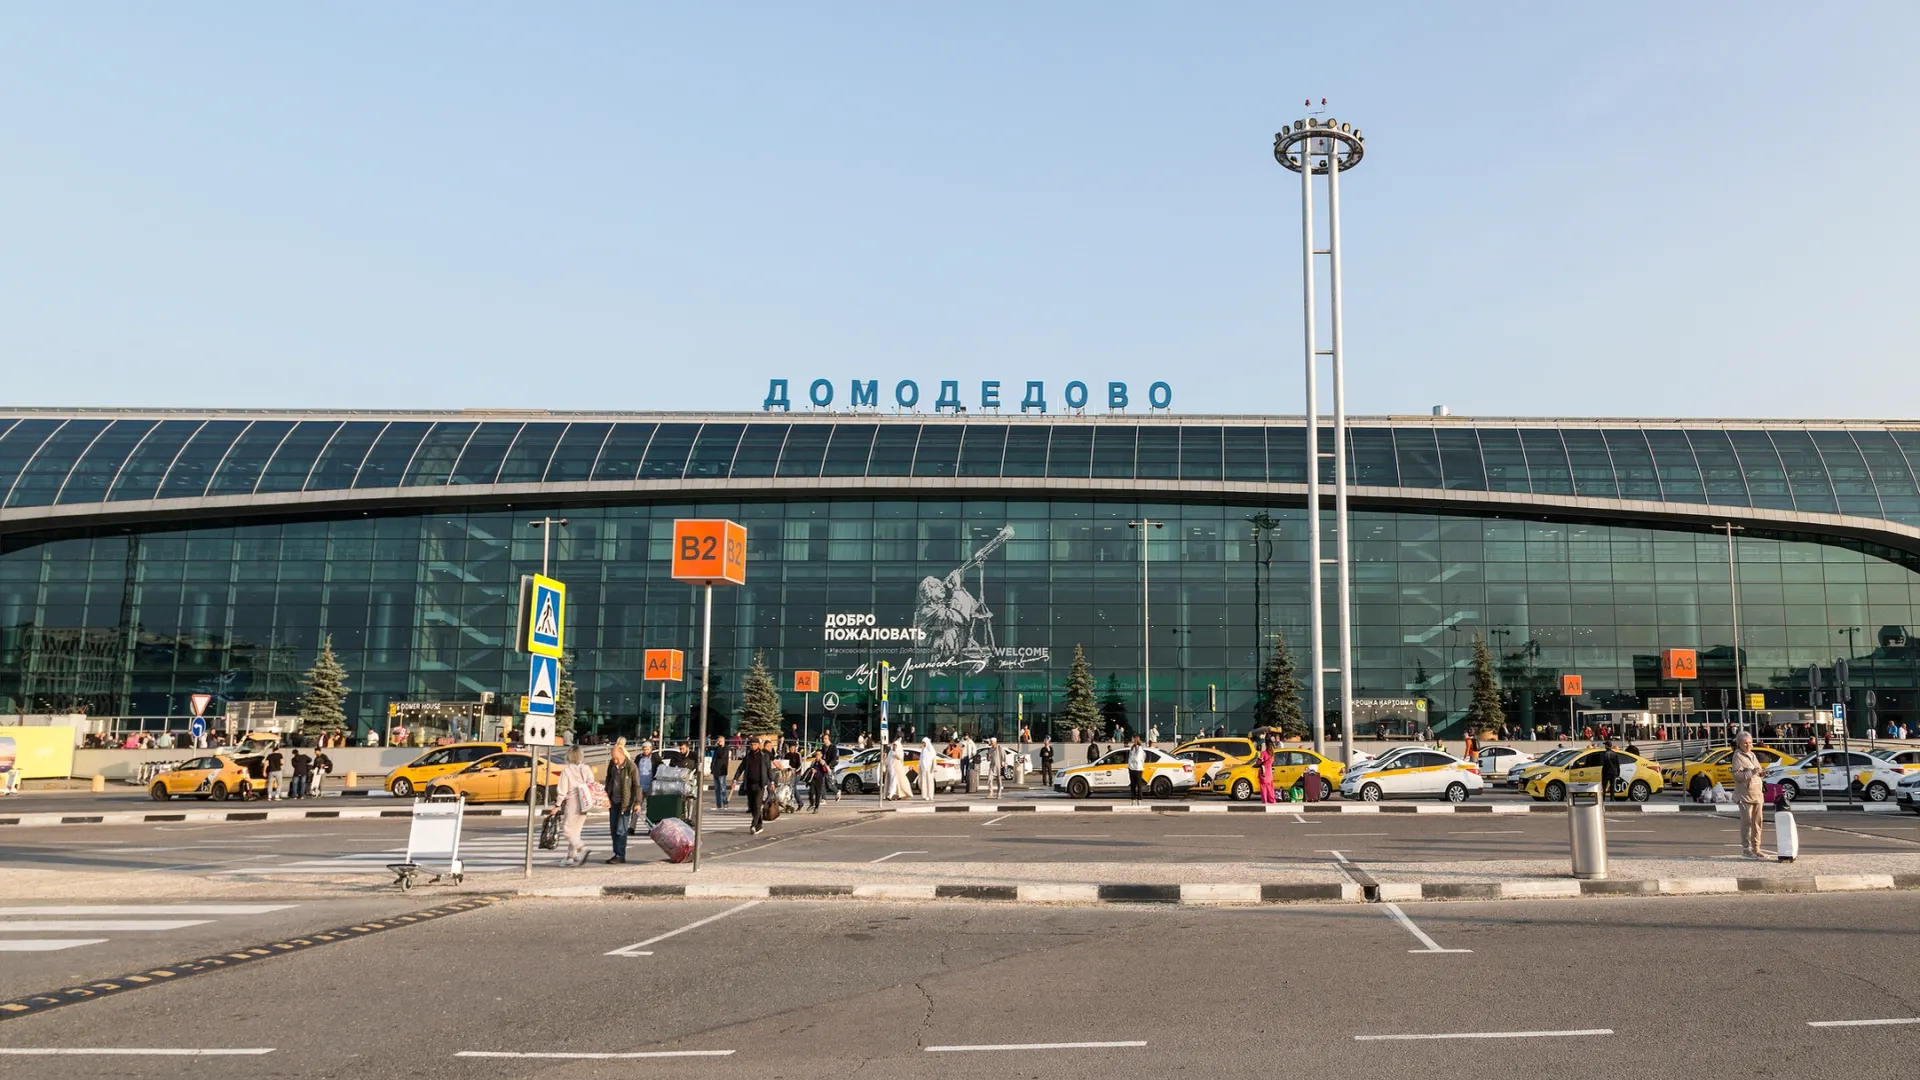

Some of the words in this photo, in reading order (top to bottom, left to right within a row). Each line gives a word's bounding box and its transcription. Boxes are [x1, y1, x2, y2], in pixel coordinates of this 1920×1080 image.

[763, 378, 1172, 412] ДОМОДЕДОВО
[681, 536, 717, 560] B2
[727, 539, 742, 566] B2
[825, 614, 876, 628] ДОБРО
[825, 628, 927, 640] ПОЖАЛОВАТЬ
[995, 647, 1049, 656] WELCOME
[648, 658, 668, 671] A4
[1675, 657, 1693, 670] A3
[797, 676, 810, 686] A2
[1567, 681, 1580, 690] A1
